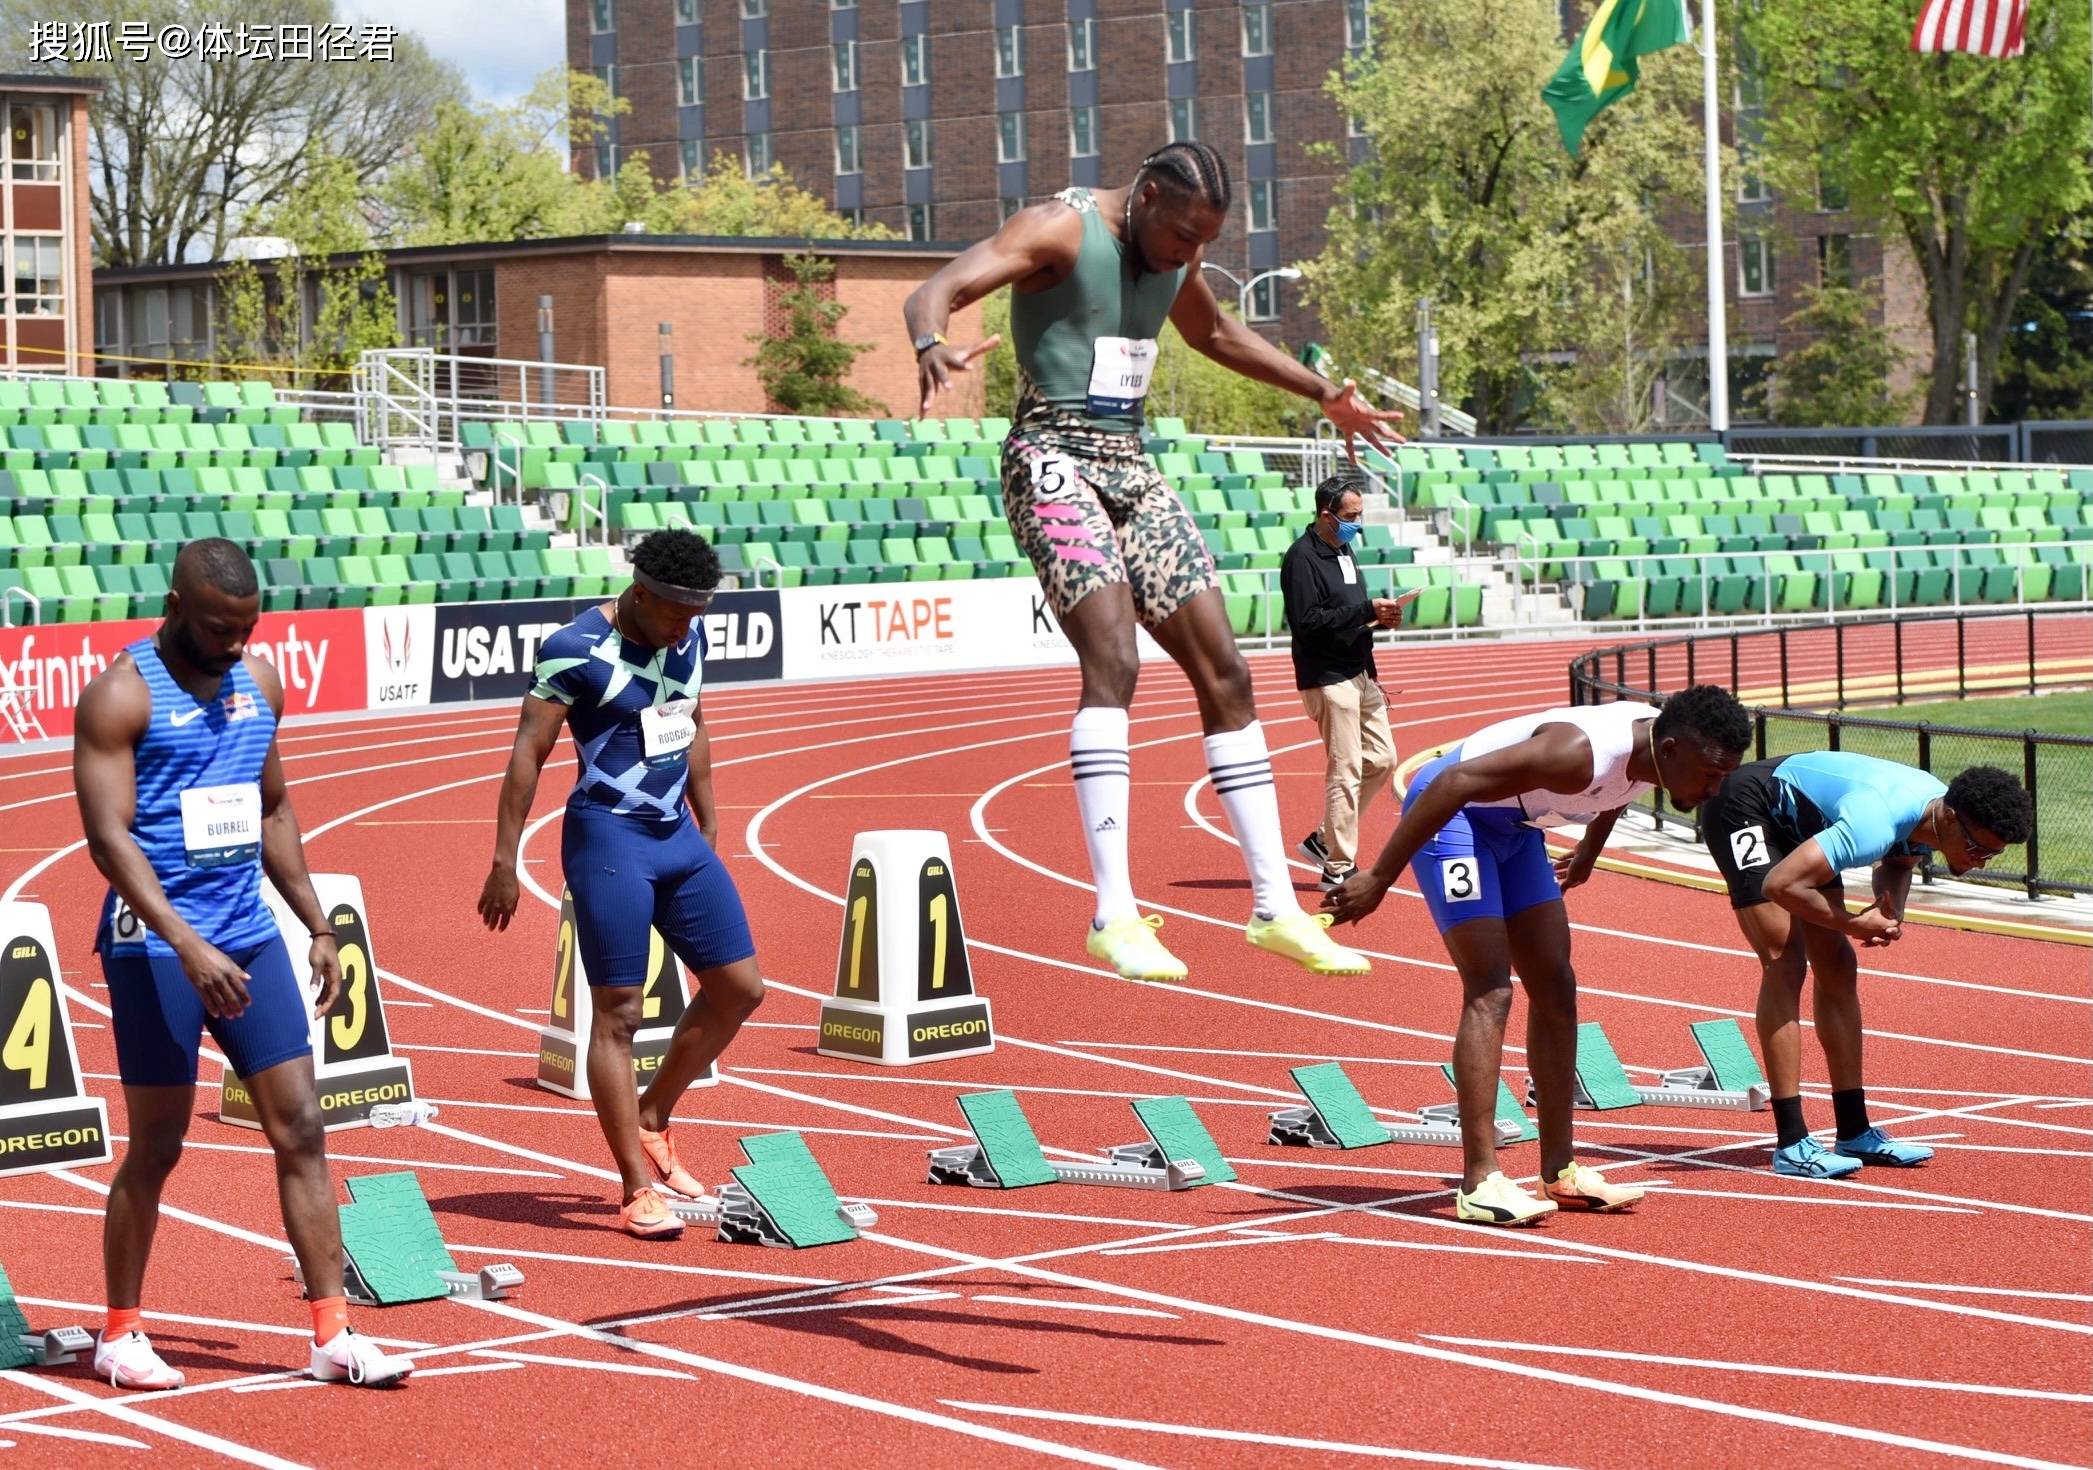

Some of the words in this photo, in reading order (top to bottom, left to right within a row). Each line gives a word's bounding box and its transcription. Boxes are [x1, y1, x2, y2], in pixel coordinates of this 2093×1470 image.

[1040, 460, 1065, 494] 5
[820, 602, 861, 645] KT
[867, 597, 954, 642] TAPE
[703, 611, 774, 661] ELD
[441, 625, 515, 679] USA
[0, 634, 120, 732] xfinit
[379, 683, 418, 701] USATF
[207, 819, 249, 837] BURRELL
[1736, 831, 1762, 867] 2
[856, 867, 871, 878] GILL
[927, 865, 945, 876] GILL
[1448, 862, 1474, 899] 3
[334, 913, 355, 926] GILL
[12, 946, 37, 959] GILL
[848, 895, 868, 989] 1
[929, 893, 948, 989] 1
[553, 919, 573, 1018] 2
[330, 943, 367, 1051] 3
[2, 977, 52, 1090] 4
[823, 1022, 881, 1044] OREGON
[912, 1019, 987, 1043] OREGON
[540, 1049, 575, 1073] OREGON
[225, 1086, 253, 1105] ORE
[319, 1083, 408, 1111] OREGON
[490, 1265, 513, 1273] GILL
[57, 1328, 84, 1337] GILL
